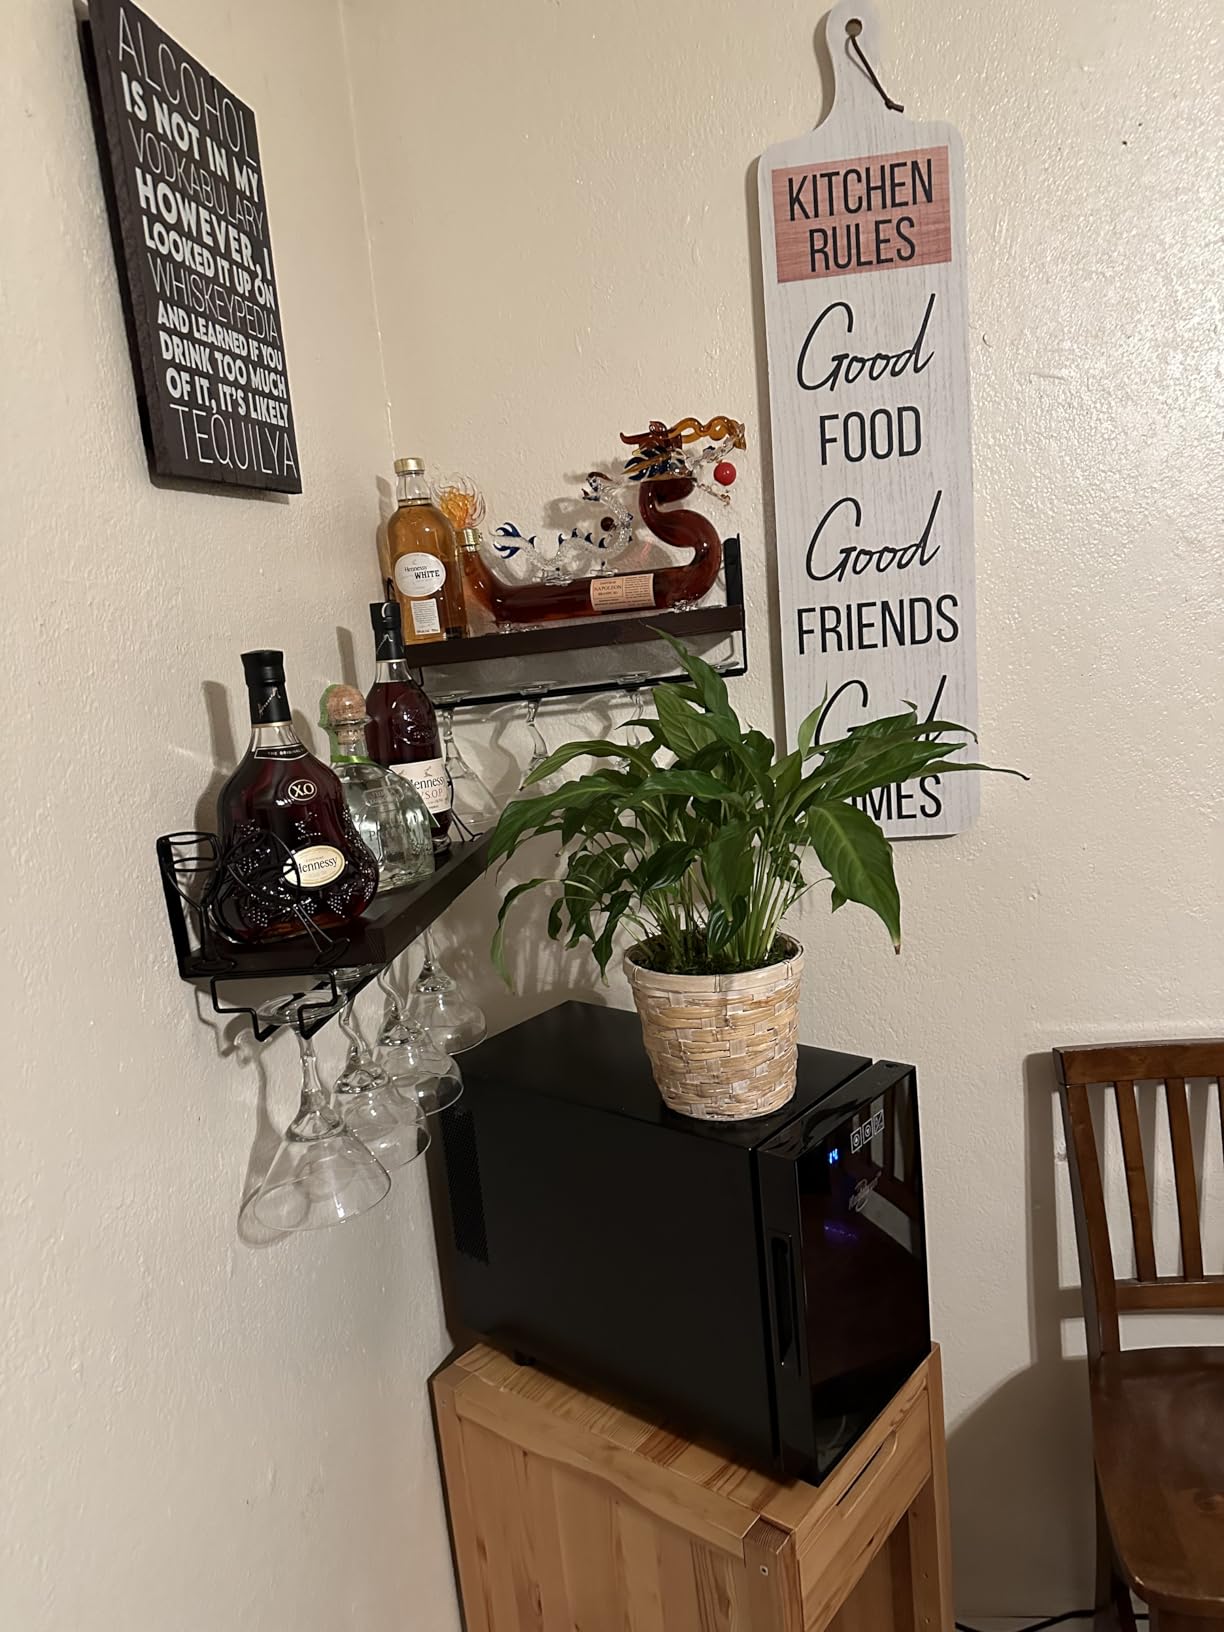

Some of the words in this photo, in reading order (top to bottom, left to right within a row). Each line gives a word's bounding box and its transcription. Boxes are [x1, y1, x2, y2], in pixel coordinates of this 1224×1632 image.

[118, 7, 257, 167] ALCOHOL
[121, 71, 147, 122] IS
[152, 94, 200, 161] NOT
[206, 136, 230, 182] IN
[233, 157, 259, 203] MY
[128, 119, 264, 241] VODKABULARY
[787, 158, 934, 221] KITCHEN
[135, 166, 263, 281] HOWEVER,
[263, 247, 272, 281] I
[808, 216, 917, 272] RULES
[142, 214, 216, 278] LOOKED
[216, 255, 231, 288] IT
[232, 264, 252, 297] UP
[254, 279, 276, 311] ON
[147, 252, 281, 346] WHISKEYPEDIA
[157, 300, 190, 334] AND
[191, 313, 249, 357] LEARNED
[248, 338, 260, 362] IF
[260, 343, 284, 371] YOU
[159, 330, 214, 375] DRINK
[214, 350, 248, 386] TOO
[248, 363, 288, 399] MUCH
[796, 293, 936, 392] Good
[165, 367, 192, 401] OF
[194, 375, 217, 414] IT,
[218, 383, 247, 416] IT'S
[248, 392, 289, 428] LIKELY
[819, 405, 922, 466] FOOD
[169, 403, 298, 479] TEQUILYA
[414, 569, 441, 579] WHITE
[806, 490, 943, 582] Good
[797, 594, 960, 655] FRIENDS
